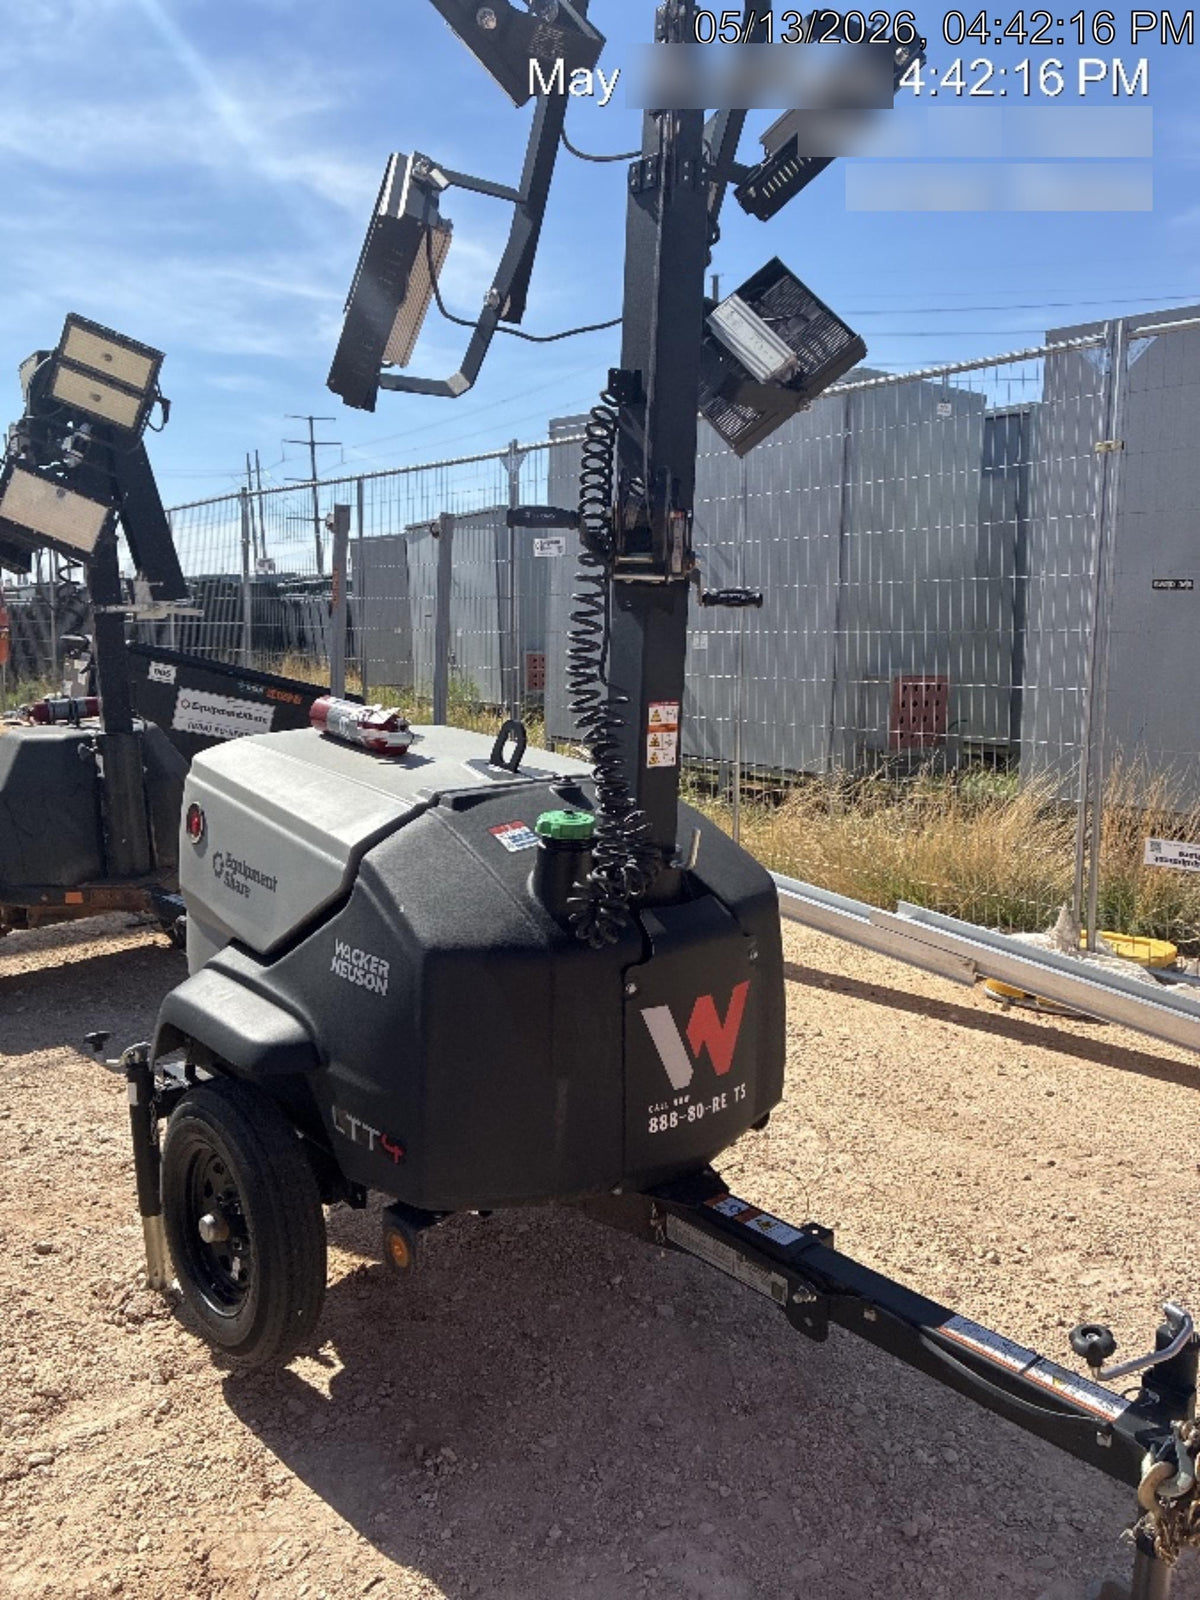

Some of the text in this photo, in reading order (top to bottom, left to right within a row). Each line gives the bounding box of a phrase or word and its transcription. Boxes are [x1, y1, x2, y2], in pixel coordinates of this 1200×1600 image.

[226, 852, 278, 892] Equipment
[330, 956, 388, 996] NEUSON
[335, 938, 390, 978] WACKER
